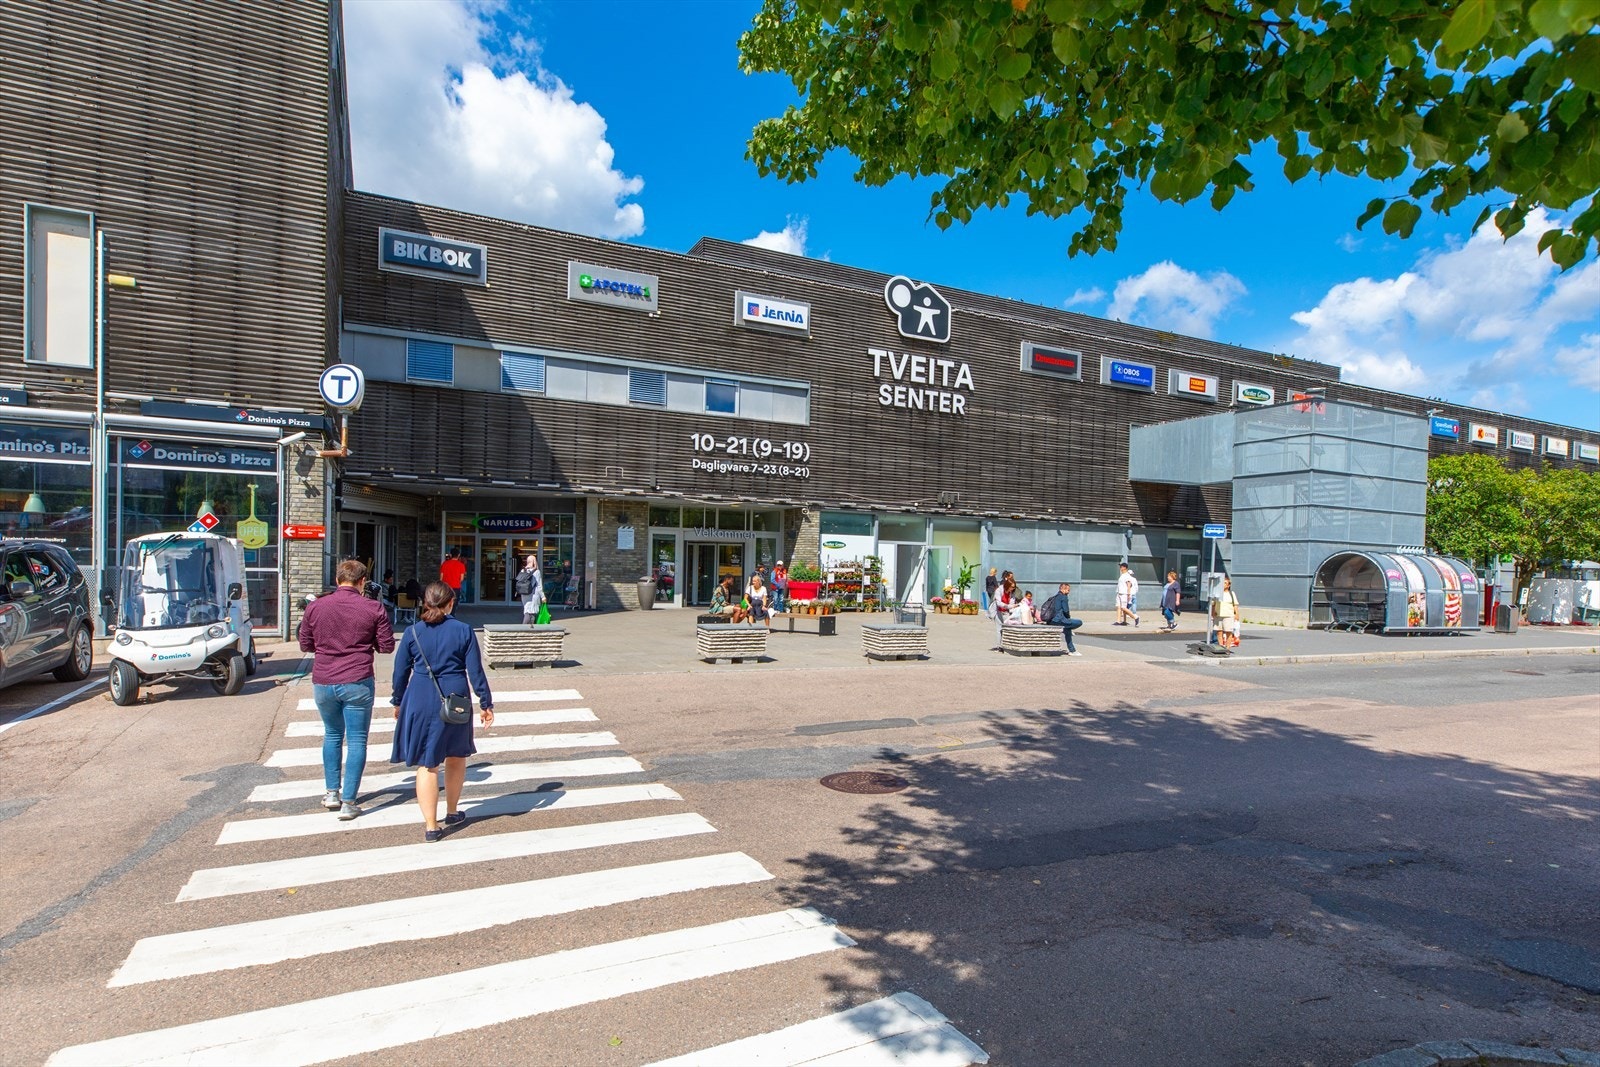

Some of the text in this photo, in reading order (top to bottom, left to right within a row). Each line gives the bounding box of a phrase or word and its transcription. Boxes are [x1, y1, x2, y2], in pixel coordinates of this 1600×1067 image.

[593, 279, 642, 295] APOTEK
[868, 348, 974, 390] TVEITA
[1123, 368, 1140, 377] OBOS
[331, 375, 351, 399] T
[879, 384, 965, 415] SENTER
[248, 415, 310, 427] Domino's Pizza
[154, 448, 271, 466] Domino's Pizza
[692, 459, 749, 473] Dagligvare
[240, 525, 266, 536] OPEN
[694, 526, 757, 539] Velkommen
[158, 652, 191, 660] Domino's
